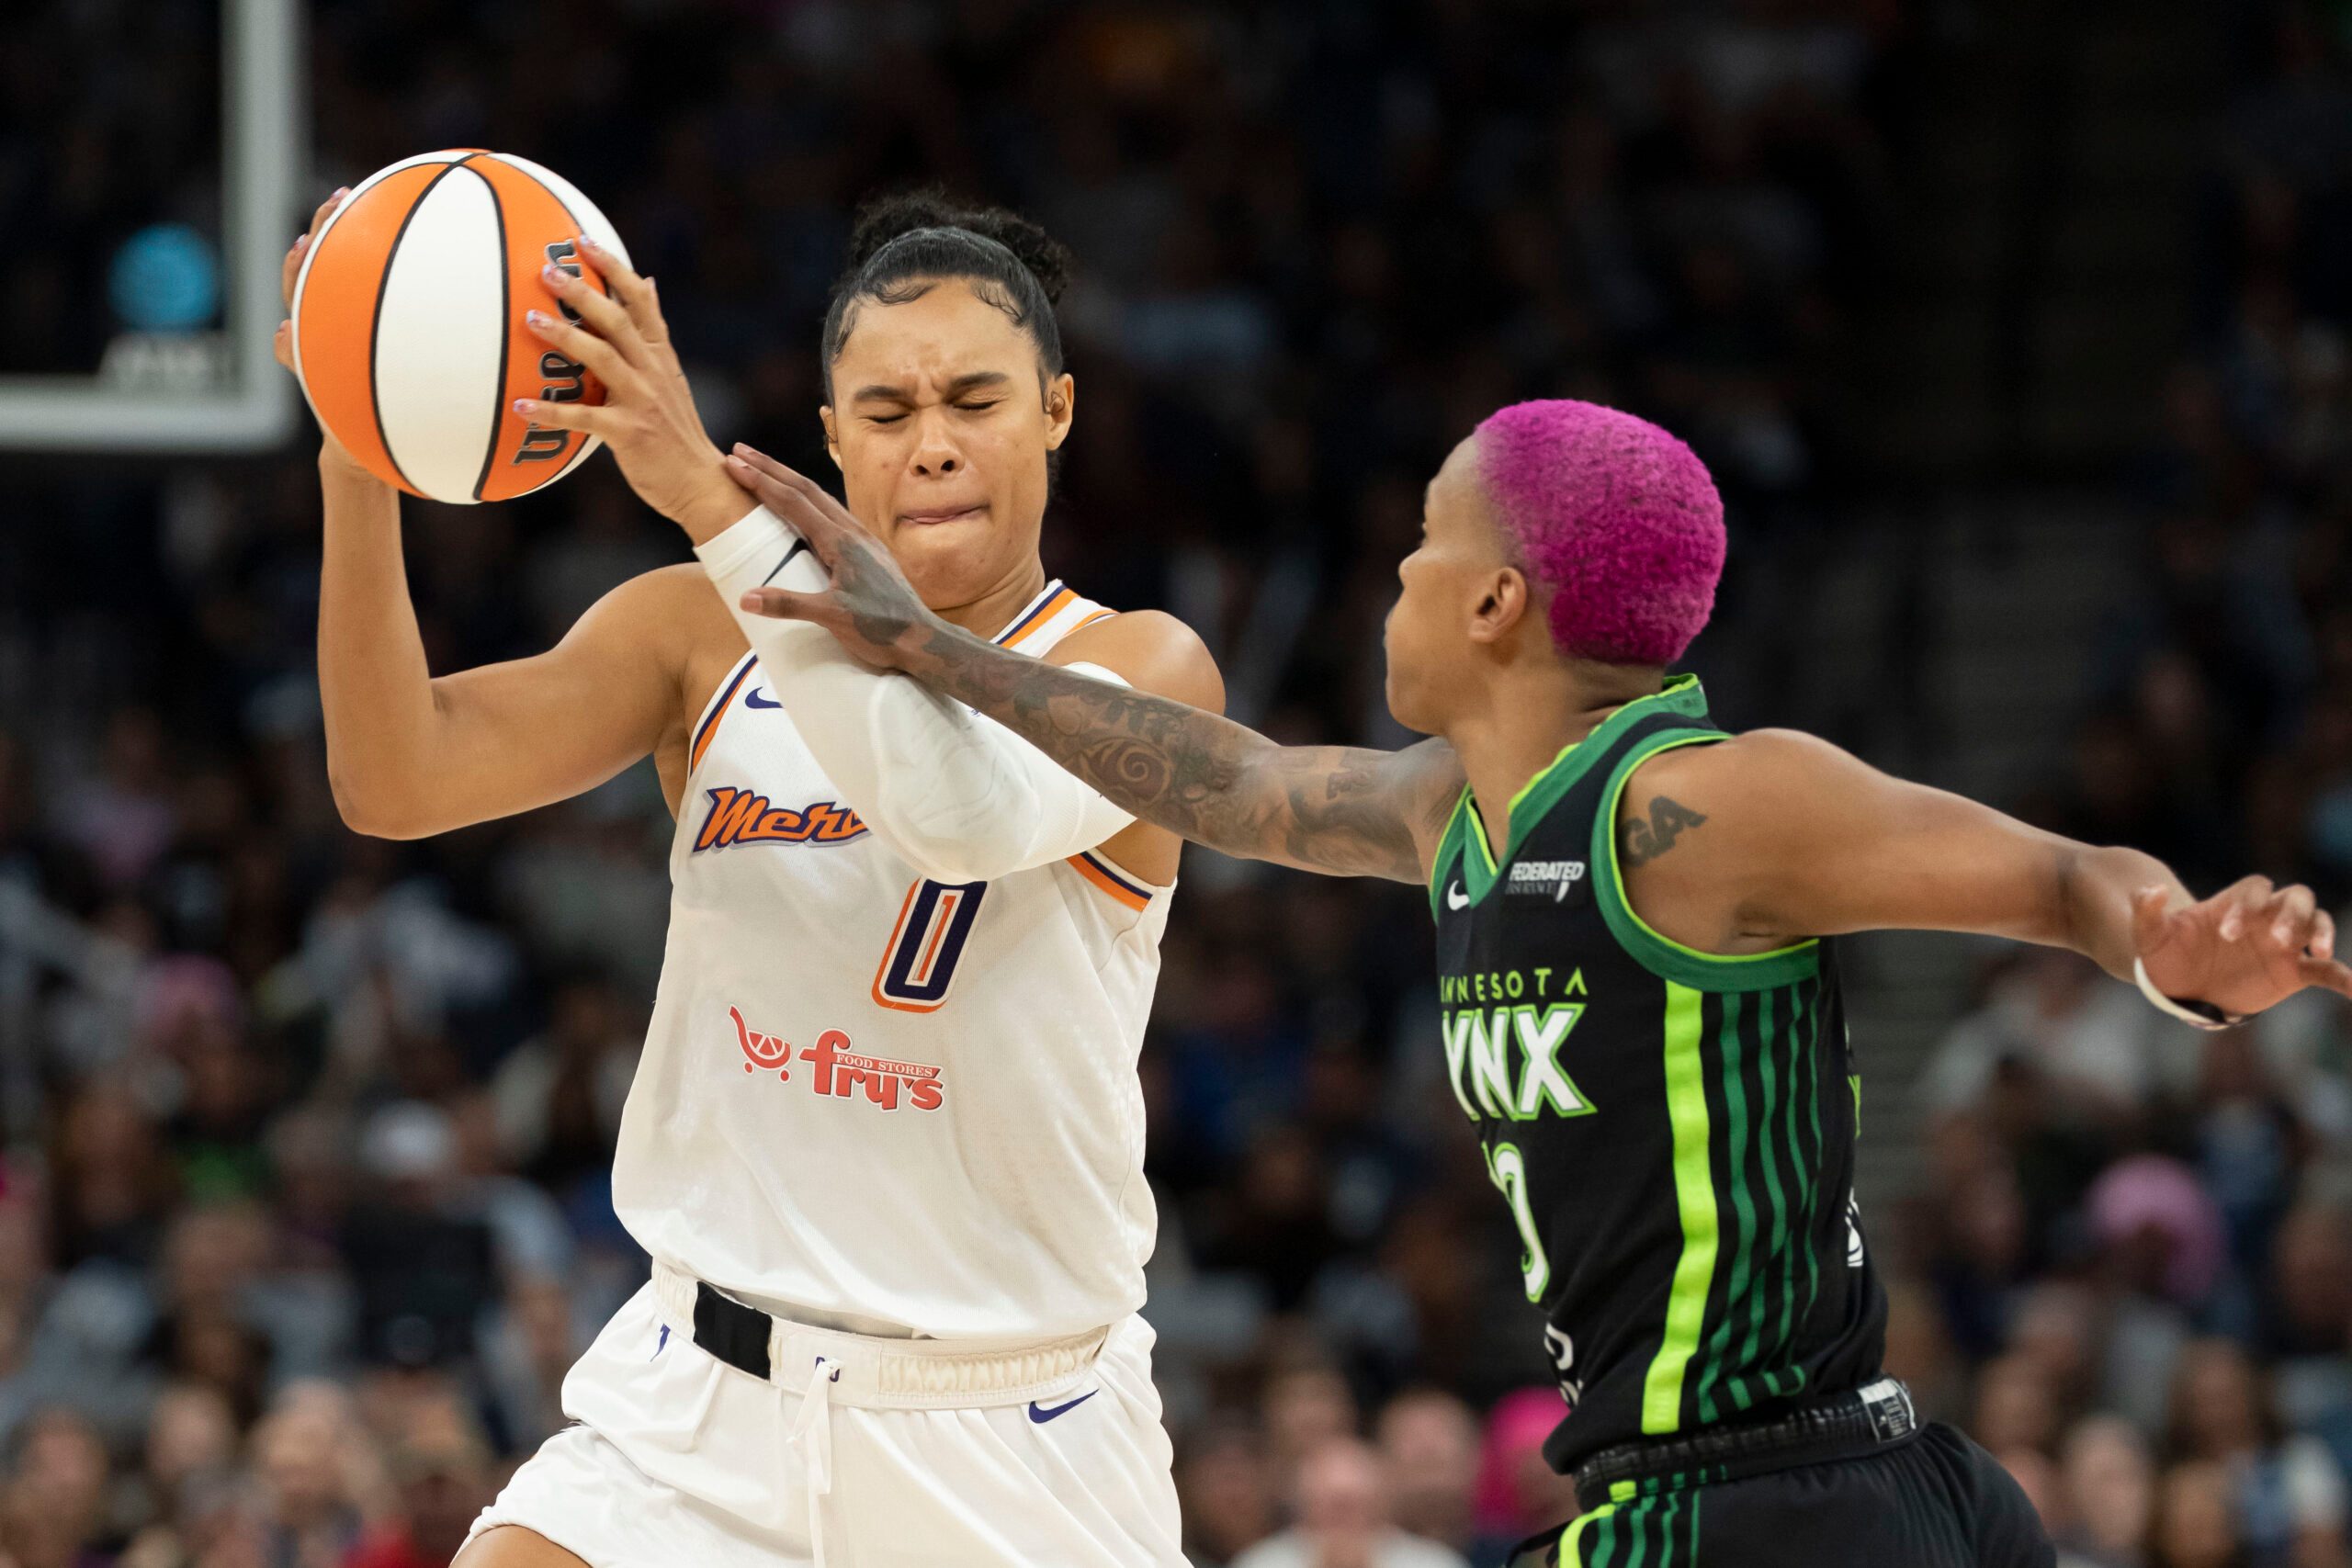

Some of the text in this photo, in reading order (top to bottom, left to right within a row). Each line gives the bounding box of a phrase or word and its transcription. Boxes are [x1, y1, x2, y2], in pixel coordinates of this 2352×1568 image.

[693, 786, 872, 852] Merc
[1509, 861, 1585, 882] FEDERATED
[871, 876, 990, 1013] 0
[1441, 967, 1589, 1003] INNESOTA
[798, 1028, 944, 1111] fry's
[836, 1054, 933, 1077] FOOD STORES
[1442, 1002, 1598, 1122] YNX
